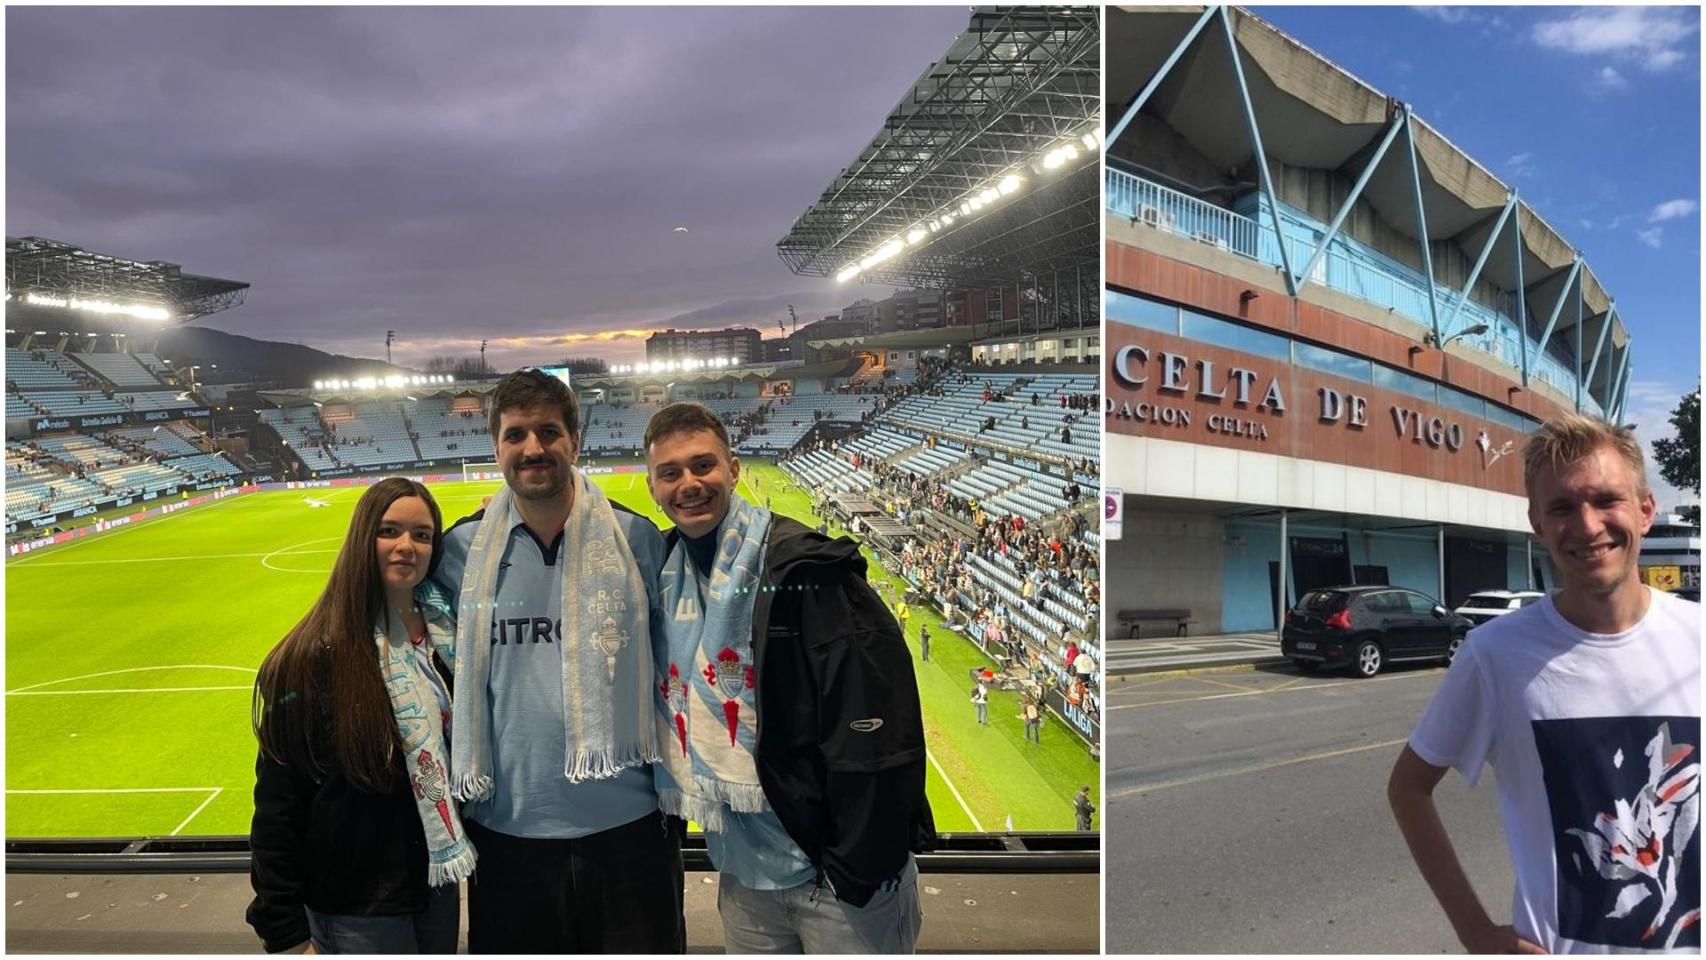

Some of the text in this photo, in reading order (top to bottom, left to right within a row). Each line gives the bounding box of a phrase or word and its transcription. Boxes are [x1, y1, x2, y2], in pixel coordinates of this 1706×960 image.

[1114, 344, 1464, 450] CELTA DE VIGO
[1208, 415, 1269, 440] CELTA
[588, 601, 627, 615] CELTA
[491, 616, 562, 646] ITR
[1063, 699, 1093, 738] LALIGA
